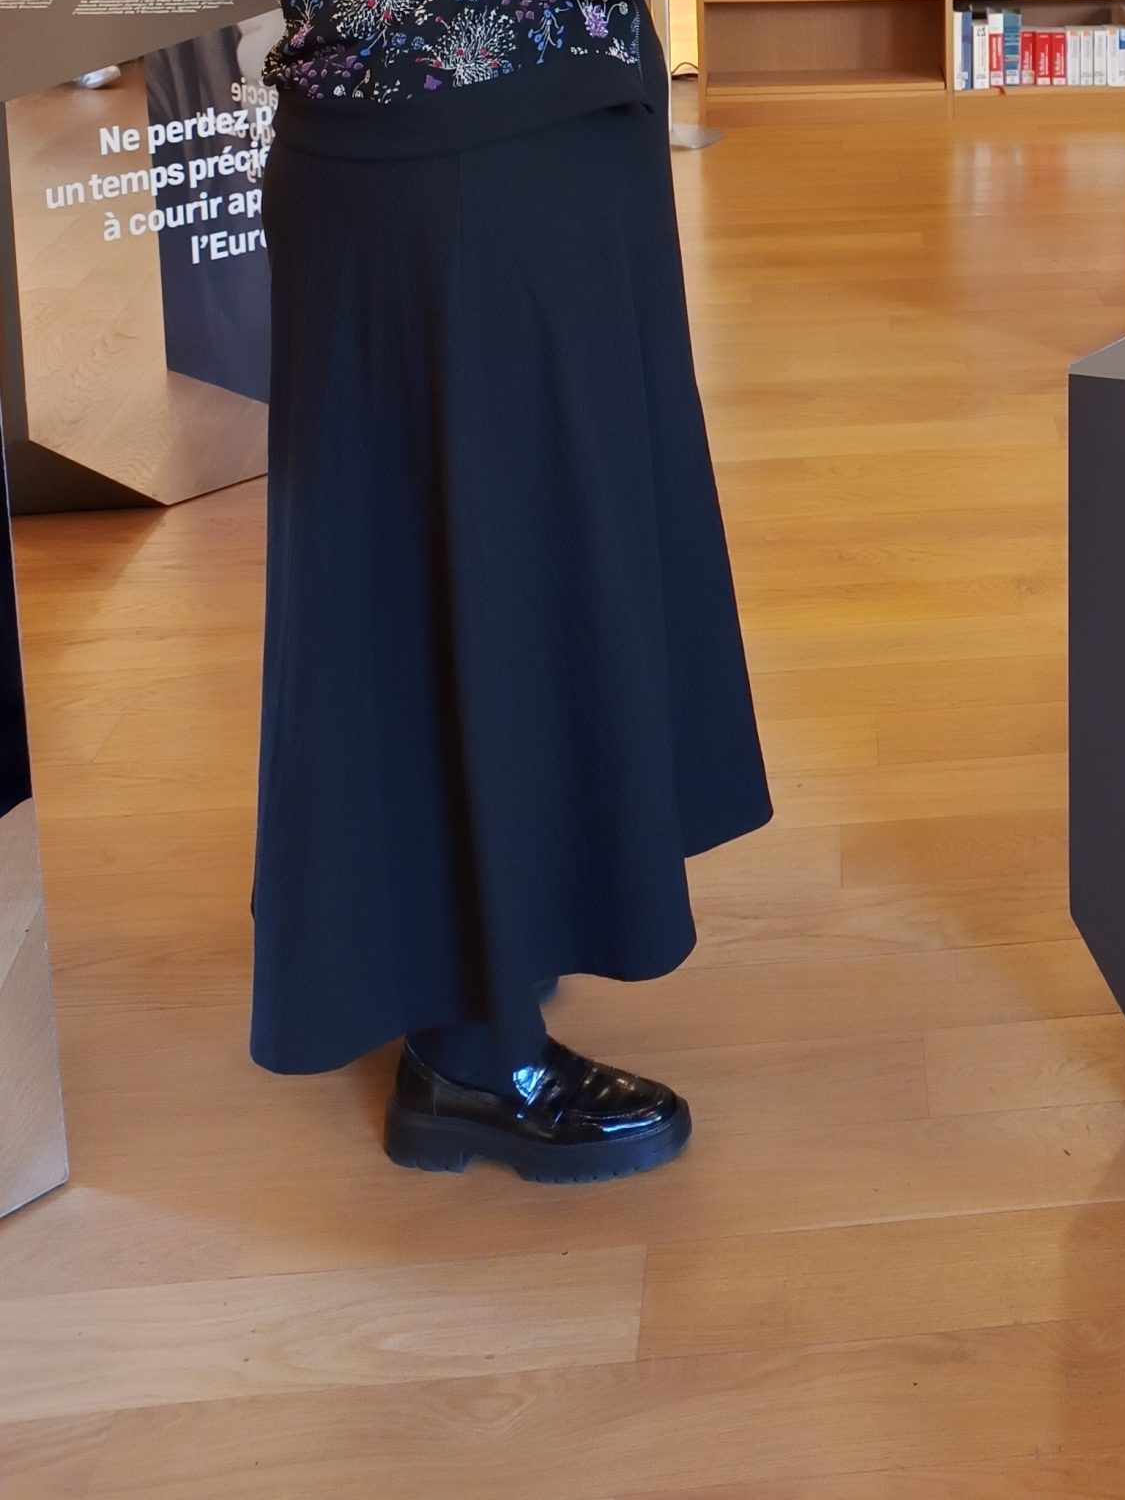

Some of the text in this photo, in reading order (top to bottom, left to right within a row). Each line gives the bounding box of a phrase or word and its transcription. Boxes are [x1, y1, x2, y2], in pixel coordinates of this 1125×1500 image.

[100, 125, 140, 155] Ne
[148, 107, 249, 154] perdez
[46, 141, 271, 209] un temps précie
[104, 188, 262, 241] à courir ap
